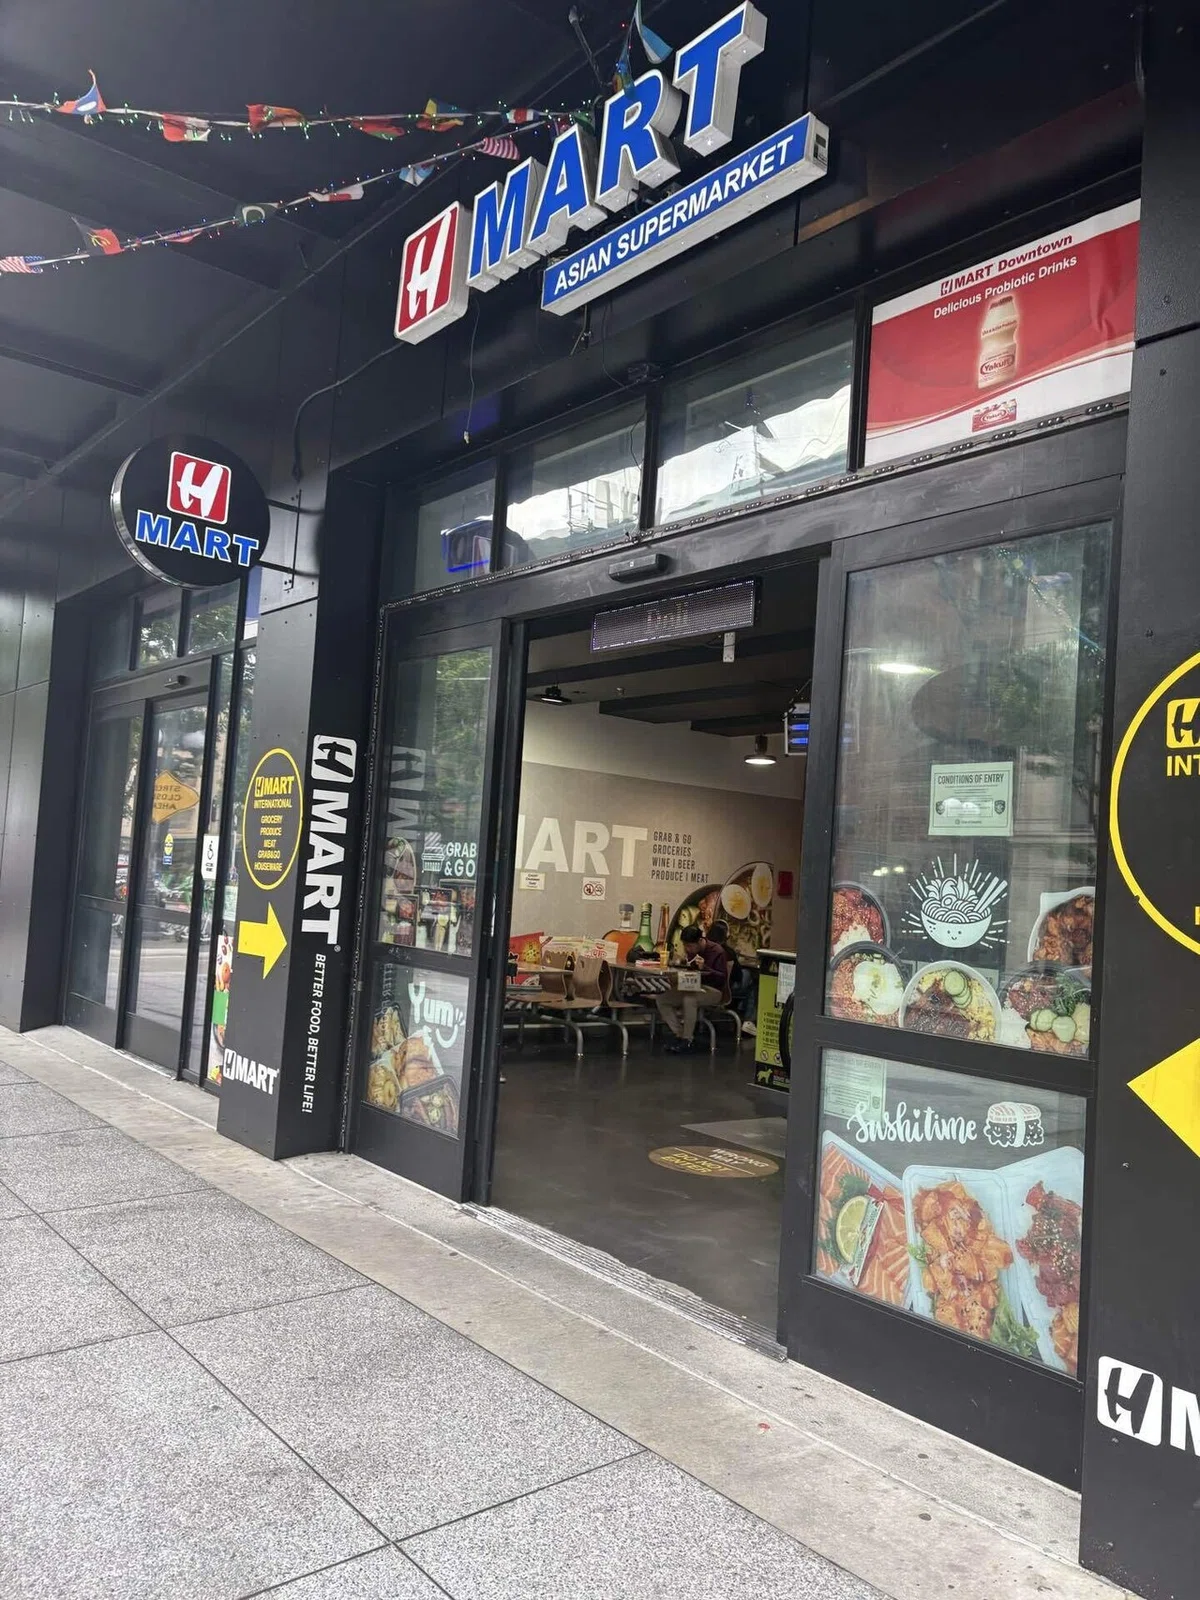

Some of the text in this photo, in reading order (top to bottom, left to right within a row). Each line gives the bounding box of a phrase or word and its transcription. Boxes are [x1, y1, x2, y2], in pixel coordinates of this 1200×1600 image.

[553, 134, 794, 295] ASIAN SUPERMARKET
[997, 234, 1073, 272] Downtown
[934, 255, 1078, 319] Delicious Probiotic Drinks
[135, 509, 259, 567] MART
[938, 773, 1004, 784] CONDITIONS OF ENTRY
[254, 799, 292, 809] INTERNATIONAL
[261, 815, 283, 824] GROCERY
[260, 827, 282, 836] PRODUCE
[653, 831, 672, 842] GRAB
[682, 834, 692, 844] GO
[446, 842, 477, 858] GRAB
[652, 844, 692, 857] GROCERIES
[652, 856, 670, 868] WINE
[677, 859, 696, 870] BEER
[651, 869, 684, 881] PRODUCE
[691, 872, 709, 884] MEAT
[408, 981, 454, 1027] Yum
[301, 953, 326, 1113] BETTER FOOD, BETTER LIFE!
